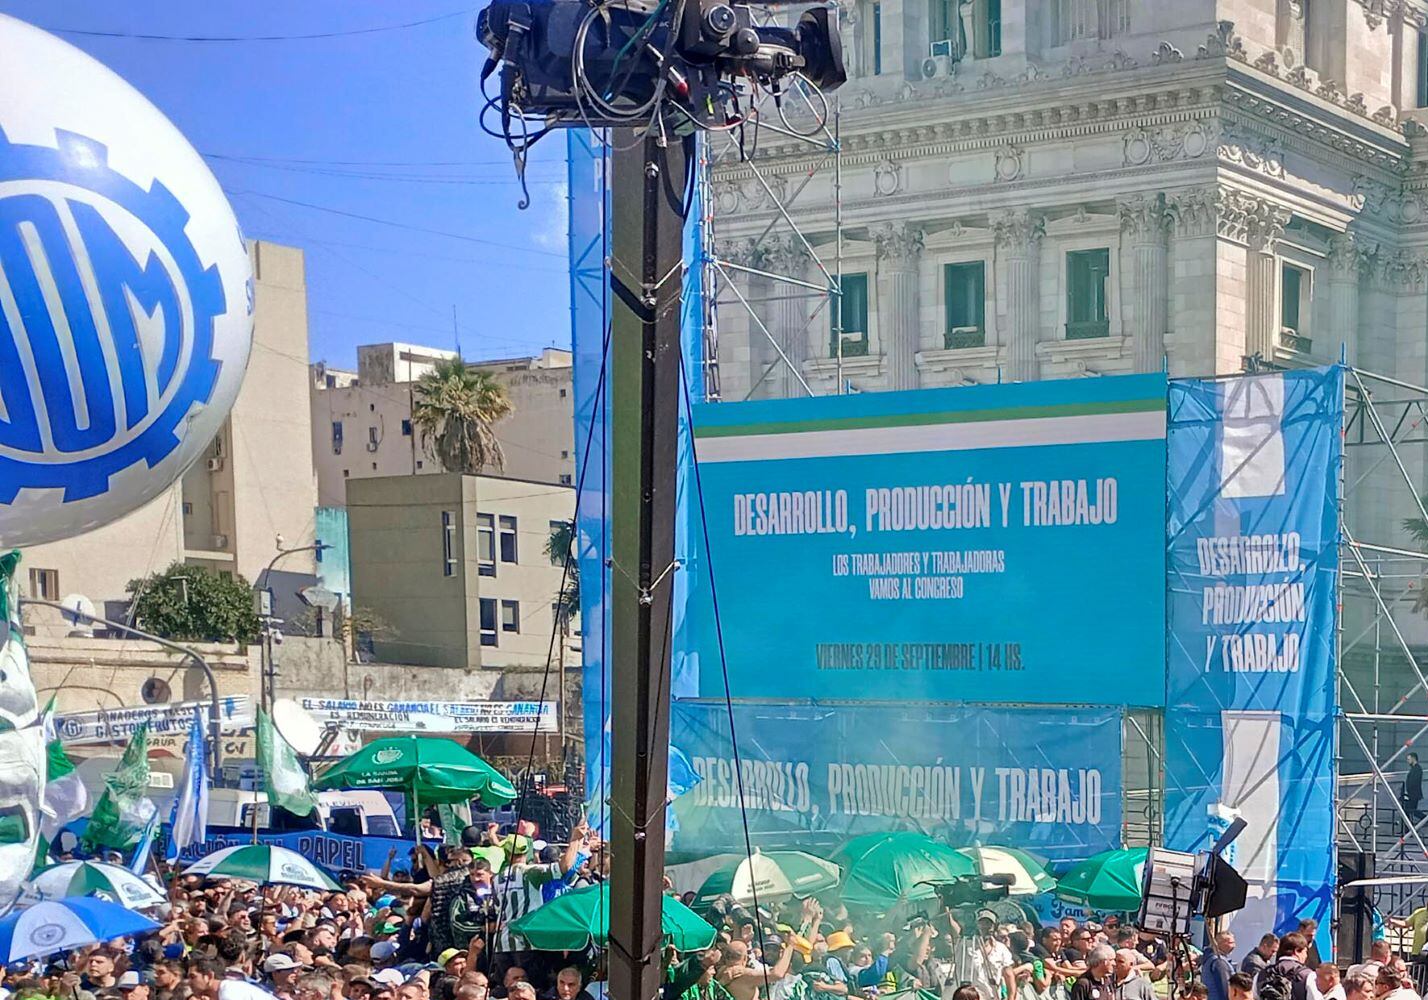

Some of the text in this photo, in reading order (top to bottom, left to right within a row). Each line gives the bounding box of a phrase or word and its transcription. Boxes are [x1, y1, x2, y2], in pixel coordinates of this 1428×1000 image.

[734, 477, 1118, 539] DESARROLLO, PRODUCCIÓN Y TRABAJO
[832, 550, 1005, 577] LOS TRABAJADORES Y TRABAJADORAS
[1196, 532, 1306, 576] DESARROLLO,
[869, 576, 964, 601] VAMOS AL CONGRESO
[1202, 577, 1306, 625] PRODUCCIÓN
[815, 643, 864, 671] VIERNES
[866, 643, 883, 671] 29
[885, 643, 899, 671] DE
[901, 642, 976, 671] SEPTIEMBRE
[986, 642, 1001, 671] 14
[1005, 642, 1025, 671] HS.
[1204, 633, 1300, 673] Y TRABAJO
[302, 699, 314, 710] EL
[692, 756, 1101, 825] DESARROLLO, PRODUCCIÓN Y TRABAJO
[300, 835, 367, 872] PAPEL
